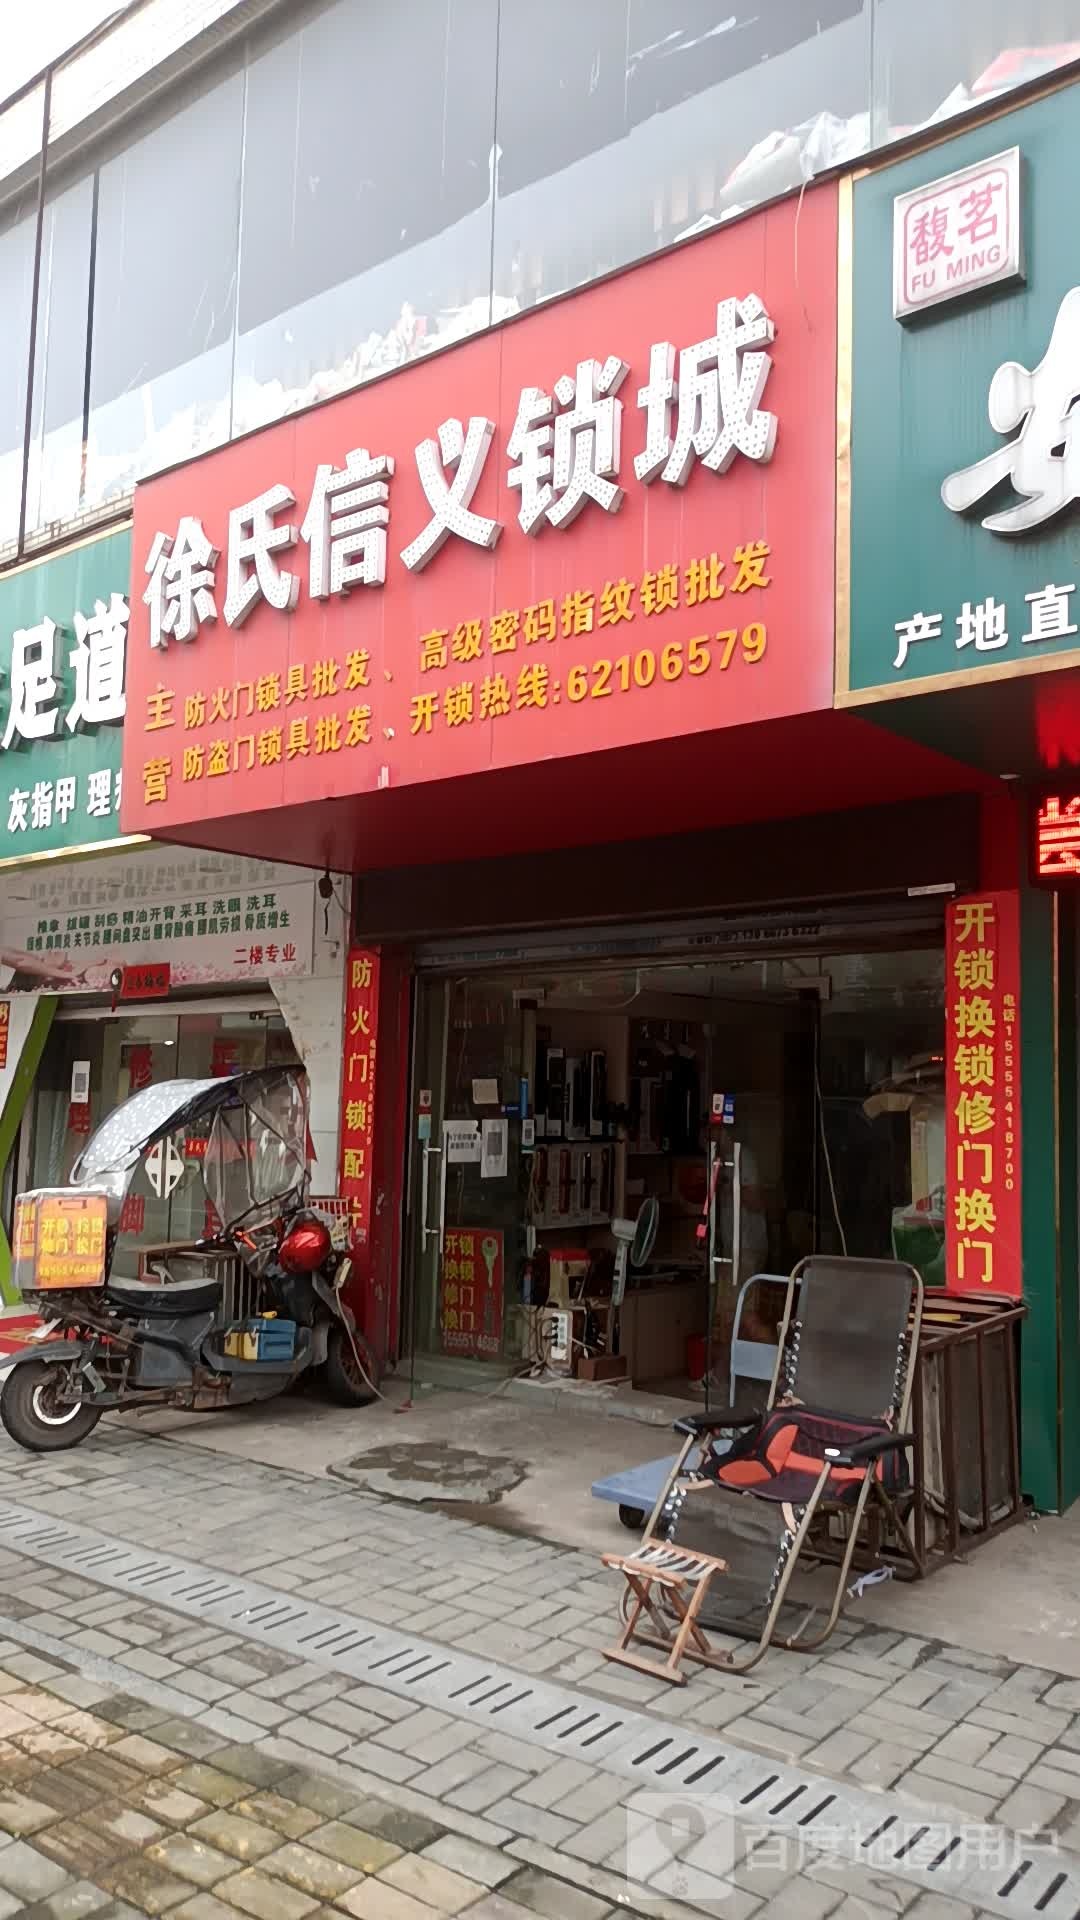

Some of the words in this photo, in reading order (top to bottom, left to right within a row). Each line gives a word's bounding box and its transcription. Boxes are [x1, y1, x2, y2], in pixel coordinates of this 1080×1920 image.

[910, 182, 1003, 266] 馥茗
[911, 269, 936, 293] FU
[946, 245, 1002, 280] MING
[142, 293, 778, 652] 徐氏信义锁城
[418, 540, 773, 673] 高级密码指纹锁批发
[893, 584, 1079, 669] 产地直
[1, 592, 130, 750] 足道
[7, 776, 77, 833] 灰指甲
[233, 942, 297, 965] 二楼专业
[954, 902, 997, 1283] 开锁换锁修门换门
